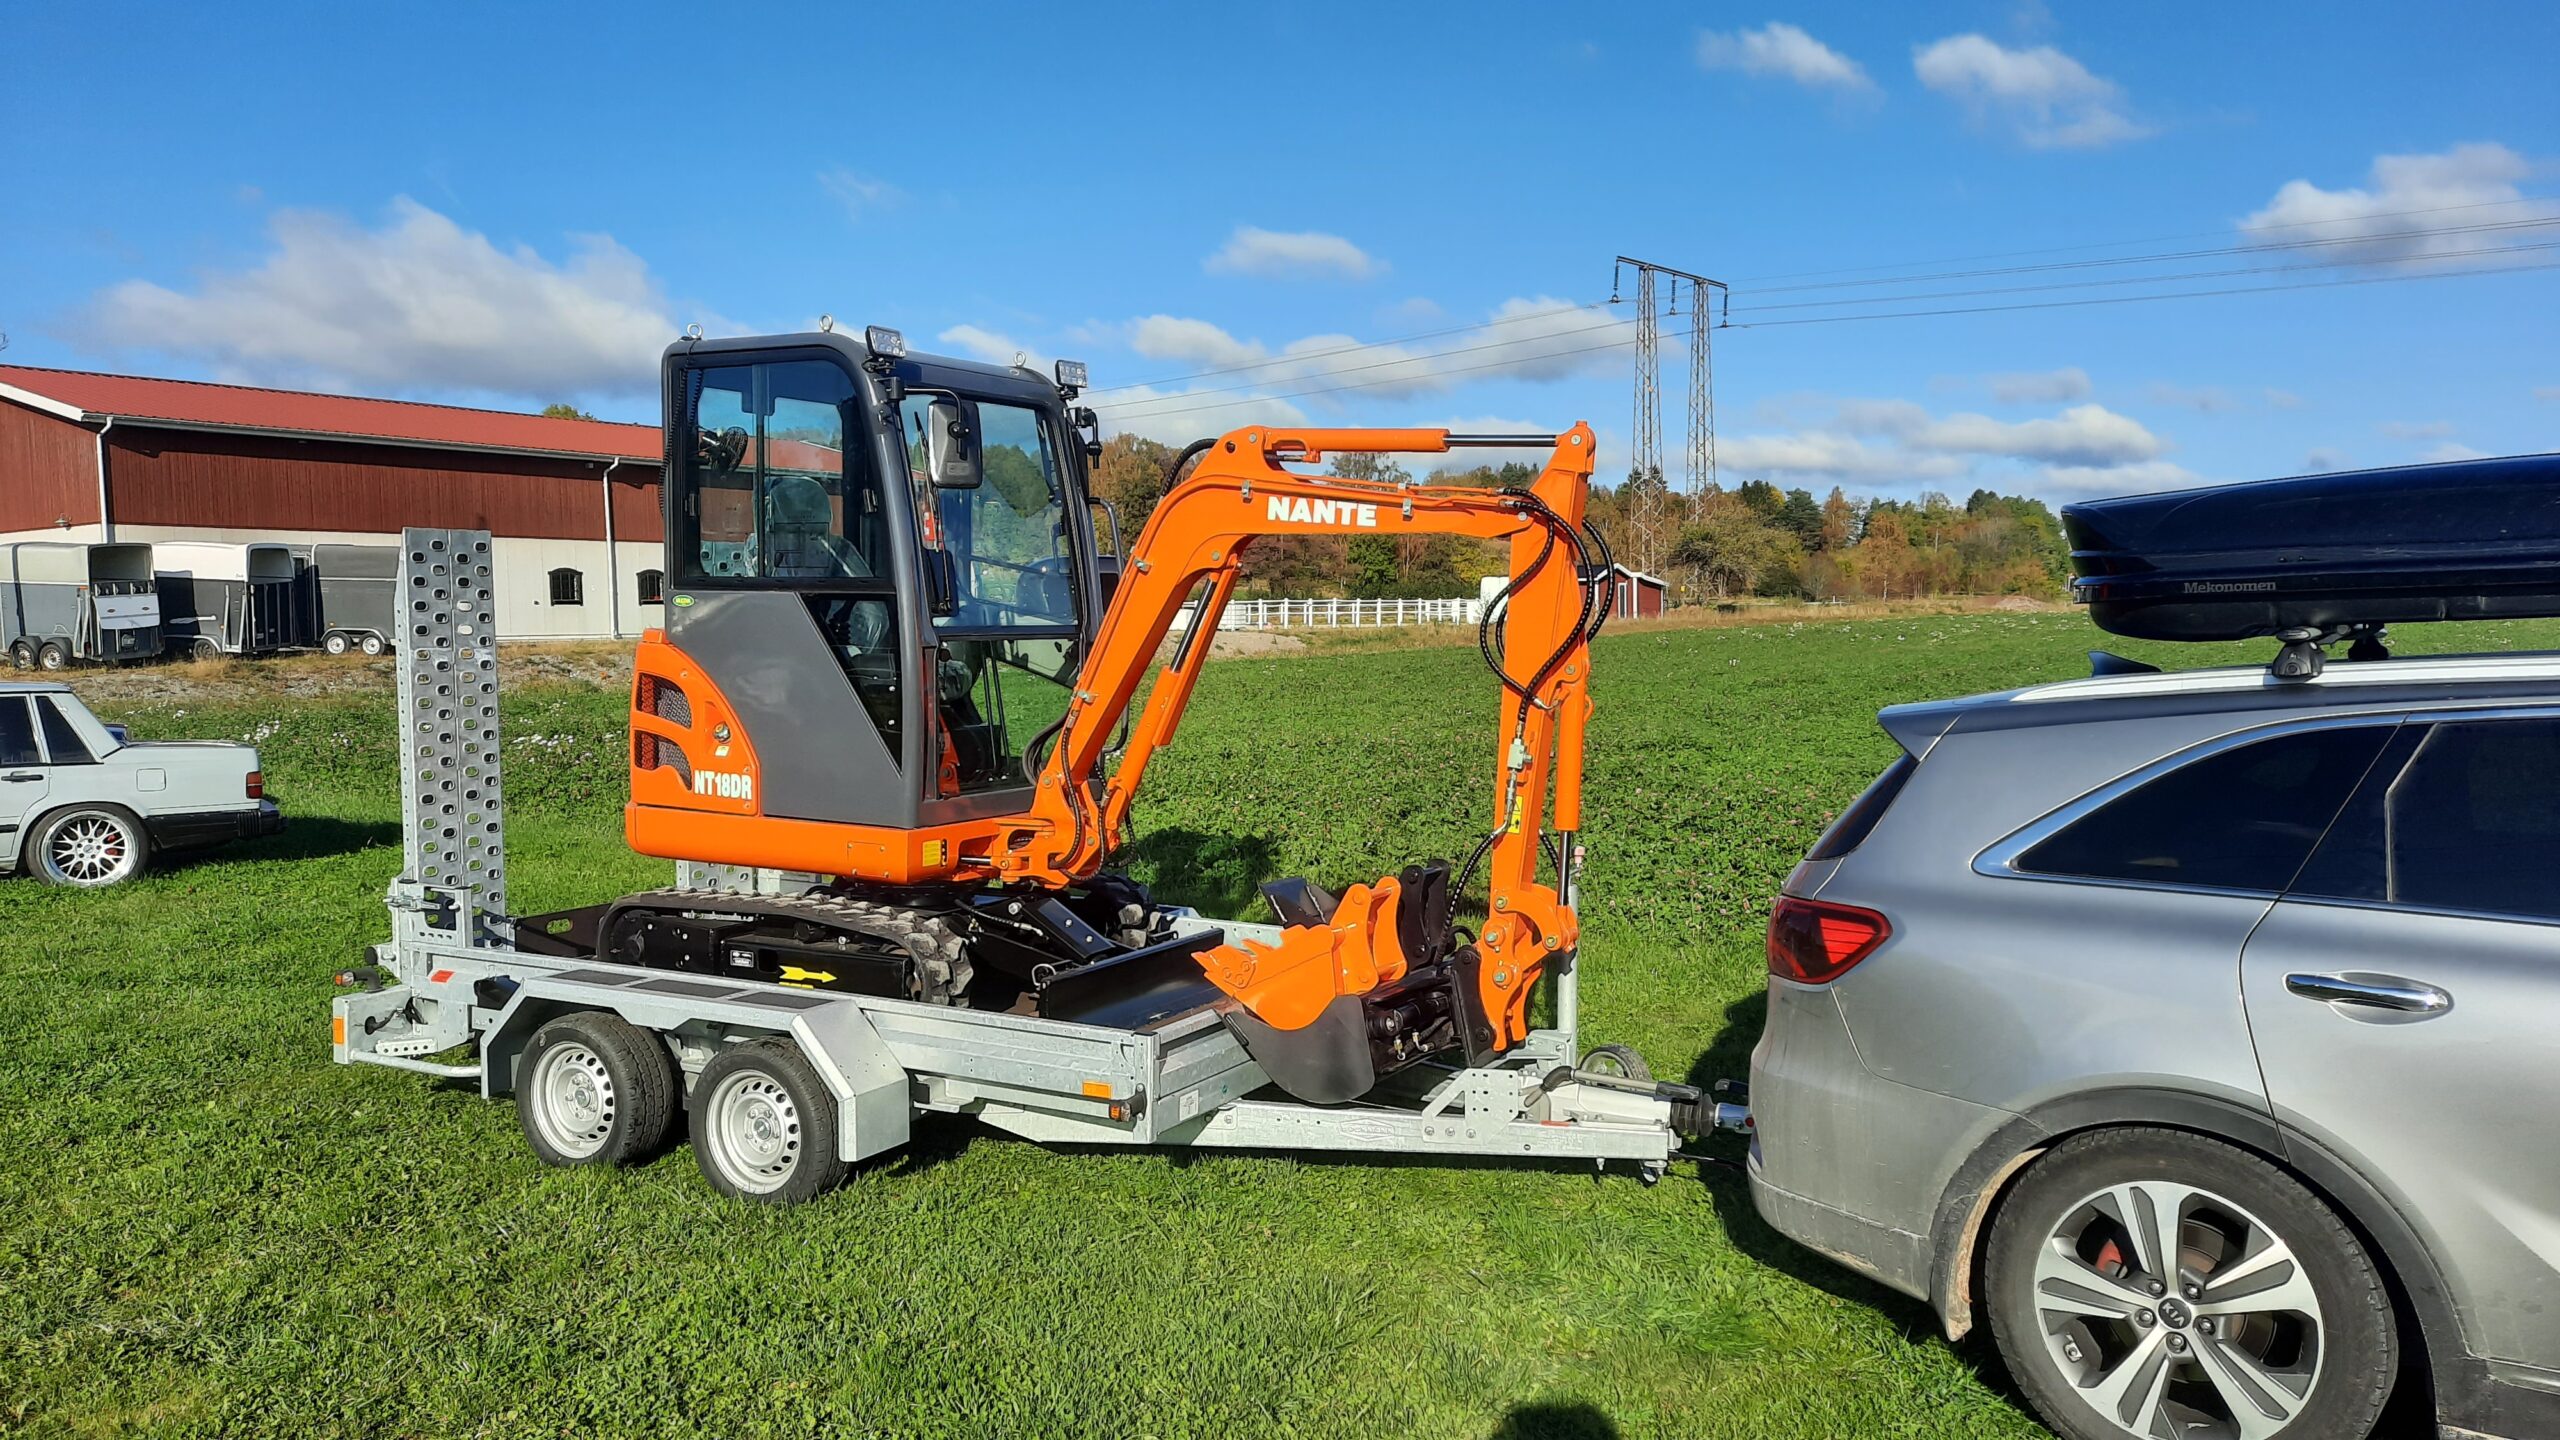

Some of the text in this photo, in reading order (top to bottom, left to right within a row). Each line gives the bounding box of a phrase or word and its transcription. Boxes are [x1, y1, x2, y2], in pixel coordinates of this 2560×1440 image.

[1267, 496, 1378, 527] NANTE
[2183, 582, 2277, 593] Mekonomen
[694, 769, 752, 800] NT18DR
[2162, 1302, 2185, 1327] KIA
